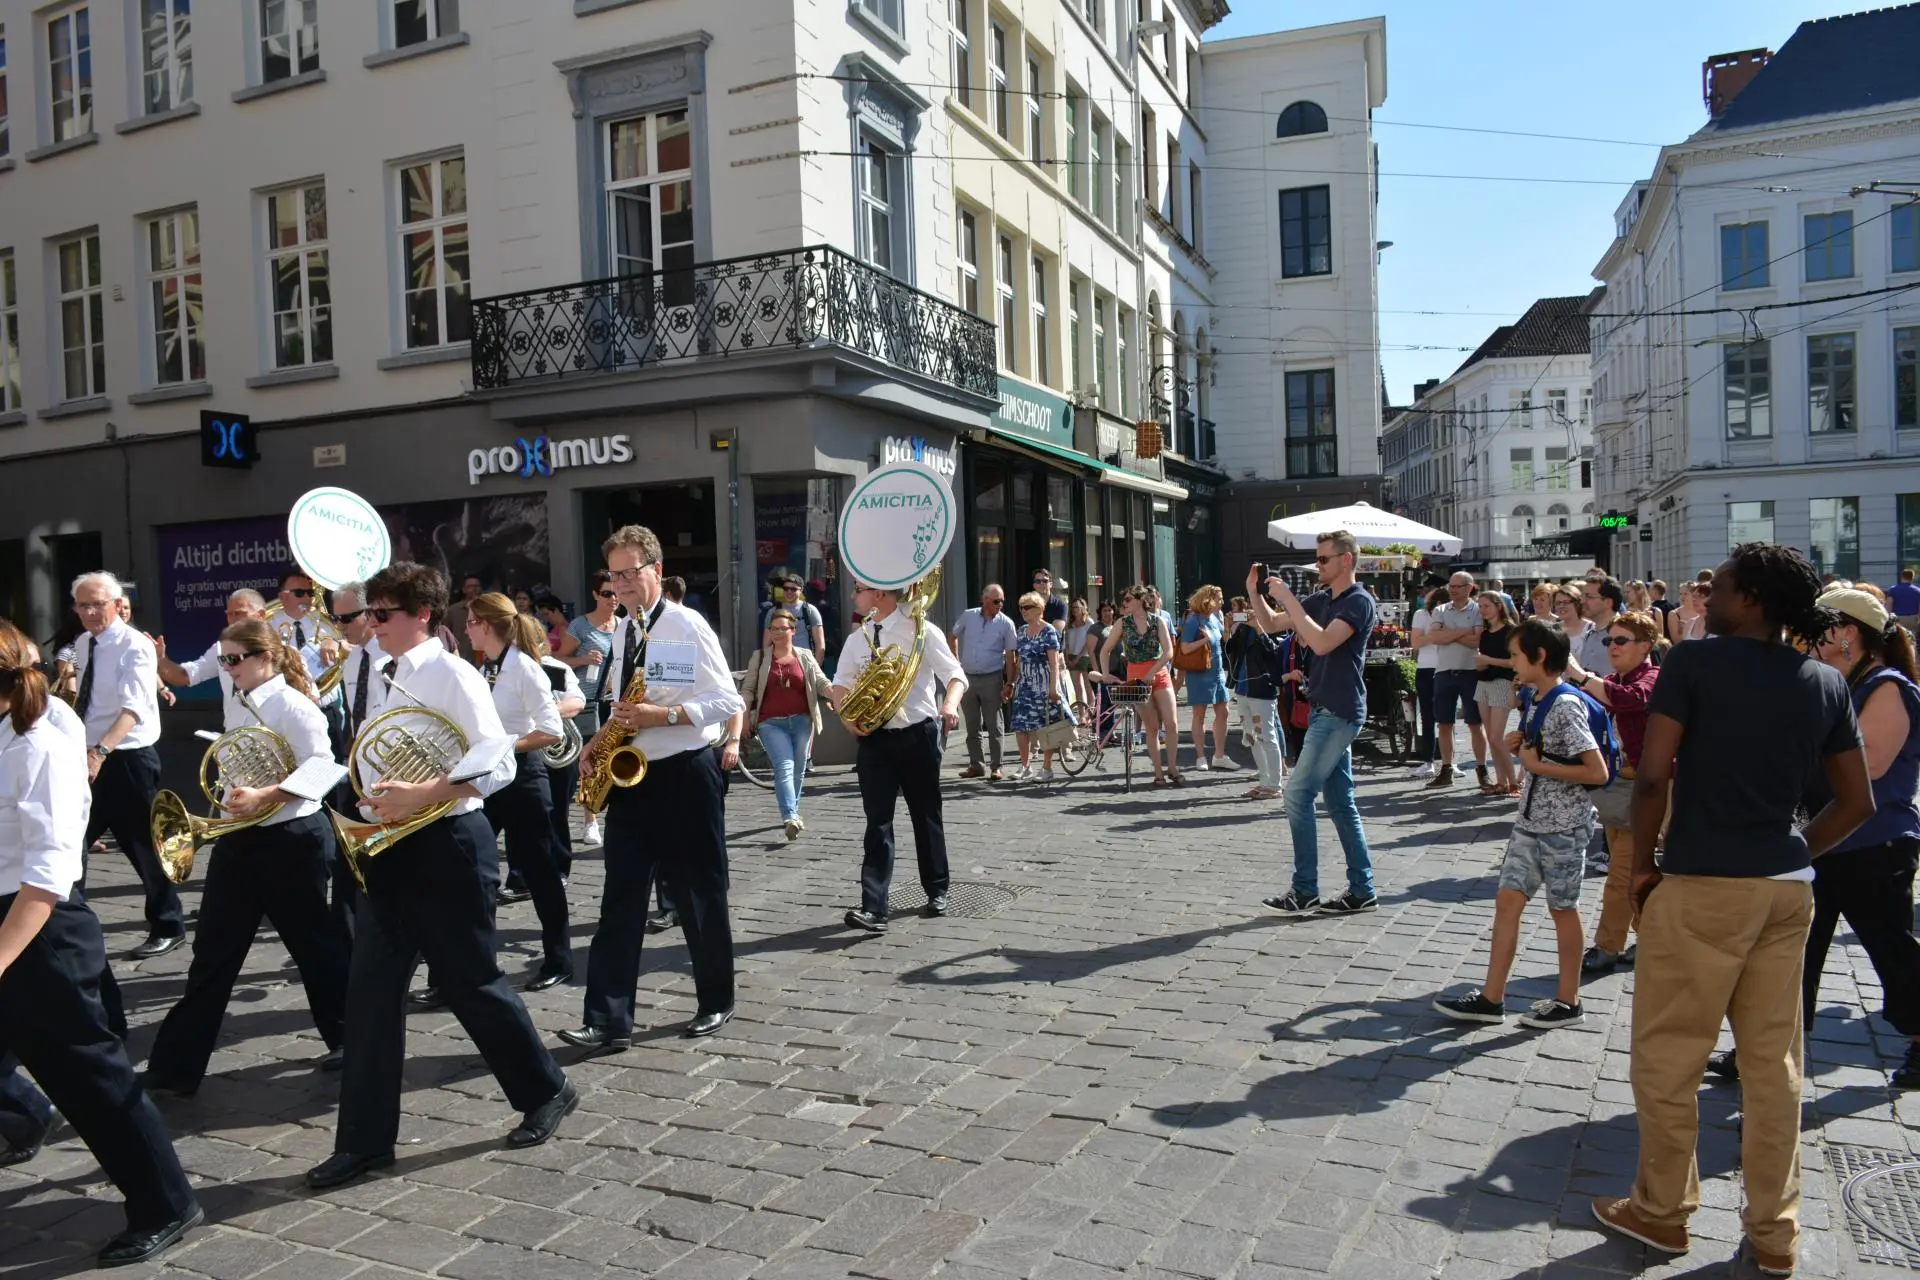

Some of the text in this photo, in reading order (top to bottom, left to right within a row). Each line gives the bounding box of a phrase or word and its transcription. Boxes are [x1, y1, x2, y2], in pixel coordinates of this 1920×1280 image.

[998, 391, 1052, 432] HIMSCHOOT
[858, 494, 933, 509] AMICITIA
[308, 503, 373, 535] AMICITIA
[173, 543, 222, 572] Altijd
[187, 580, 215, 595] gratis
[193, 595, 213, 608] hier
